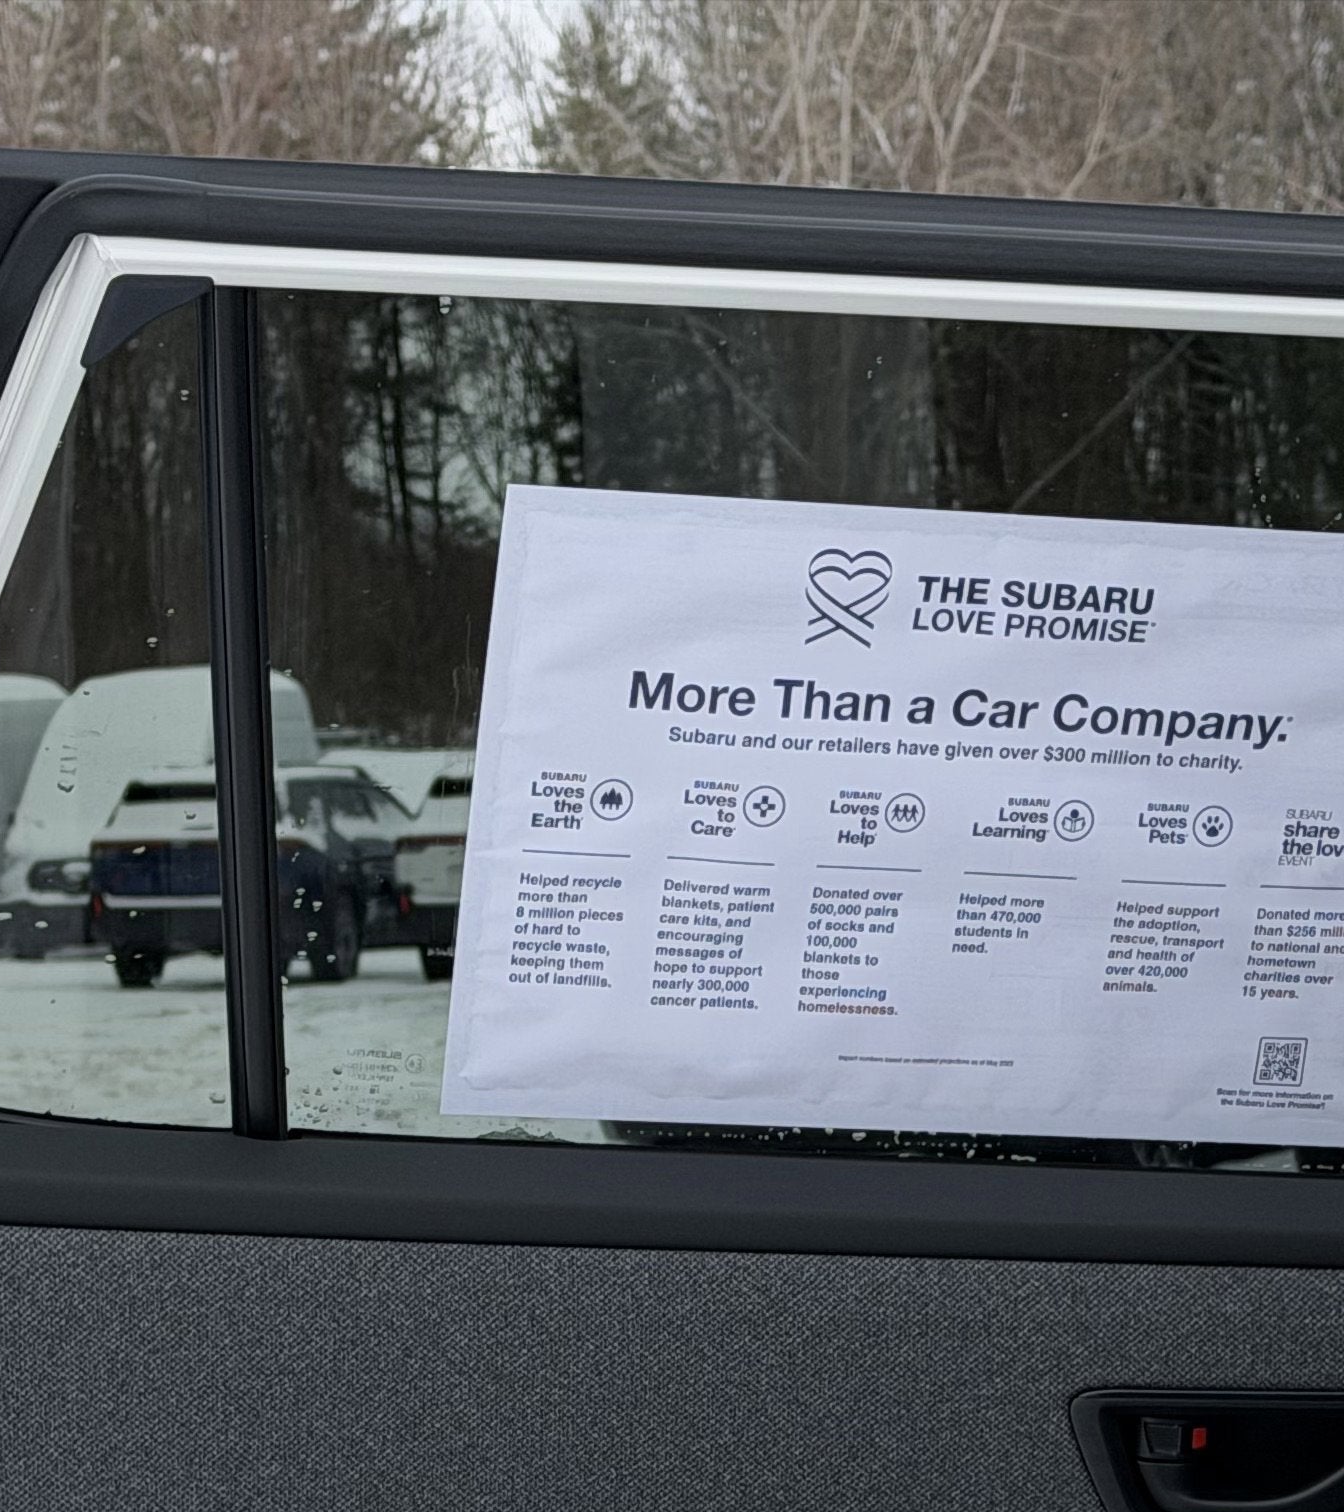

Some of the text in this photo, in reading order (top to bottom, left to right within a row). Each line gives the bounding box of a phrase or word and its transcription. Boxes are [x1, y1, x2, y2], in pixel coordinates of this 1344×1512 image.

[918, 575, 1155, 616] THE SUBARU
[912, 607, 996, 636] LOVE
[628, 670, 756, 717] More
[773, 678, 891, 723] Than
[906, 696, 935, 725] a
[952, 689, 1040, 729] Car
[668, 726, 1243, 774] Subaru and our retailers have given over $300 million to charity.
[541, 772, 587, 782] SUBARU
[532, 782, 584, 798] Loves
[694, 781, 739, 792] SUBARU
[684, 790, 736, 807] Loves
[840, 791, 882, 800] SUBARU
[1008, 798, 1050, 807] SUBARU
[554, 799, 582, 813] the
[830, 800, 879, 815] Loves
[1148, 803, 1189, 812] SUBARU
[717, 809, 735, 823] to
[999, 807, 1048, 823] Loves
[1139, 813, 1187, 829] Loves
[1286, 809, 1332, 821] SUBARU
[861, 817, 877, 830] to
[1284, 823, 1340, 839] share
[1283, 839, 1313, 855] the
[1278, 855, 1315, 866] EVENT
[519, 872, 623, 891] Helped recycle
[663, 879, 771, 897] Delivered warm
[517, 891, 588, 904] more than
[812, 886, 904, 902] Donated over
[959, 892, 1045, 909] Helped more
[661, 895, 775, 914] blankets, patient
[809, 902, 899, 920] 500,000 pairs
[1116, 900, 1220, 920] Helped support
[515, 905, 624, 923] 8 million pieces
[659, 913, 752, 929] care kits, and
[956, 908, 1042, 924] than 470,000
[1256, 907, 1311, 921] Donated
[513, 922, 581, 936] of hard to
[807, 918, 895, 934] of socks and
[954, 925, 1029, 939] students in
[1113, 916, 1201, 935] the adoption,
[1253, 924, 1283, 937] than
[1286, 924, 1317, 938] $256
[656, 930, 744, 947] encouraging
[806, 934, 858, 950] 100,000
[1109, 933, 1225, 951] rescue, transport
[1250, 939, 1265, 952] to
[1266, 940, 1321, 954] national
[512, 939, 610, 957] recycle waste,
[655, 946, 744, 961] messages of
[951, 941, 989, 954] need.
[1107, 948, 1196, 963] and health of
[510, 954, 604, 971] keeping them
[803, 950, 879, 967] blankets to
[1246, 954, 1317, 969] hometown
[653, 960, 763, 979] hope to support
[801, 967, 840, 981] those
[1105, 964, 1189, 979] over 420,000
[1243, 969, 1334, 985] charities over
[508, 971, 612, 988] out of landfills.
[652, 977, 750, 994] nearly 300,000
[1102, 980, 1158, 993] animals.
[799, 985, 887, 1003] experiencing
[1242, 985, 1299, 1001] 15 years.
[650, 995, 759, 1011] cancer patients.
[797, 999, 898, 1016] homelessness.
